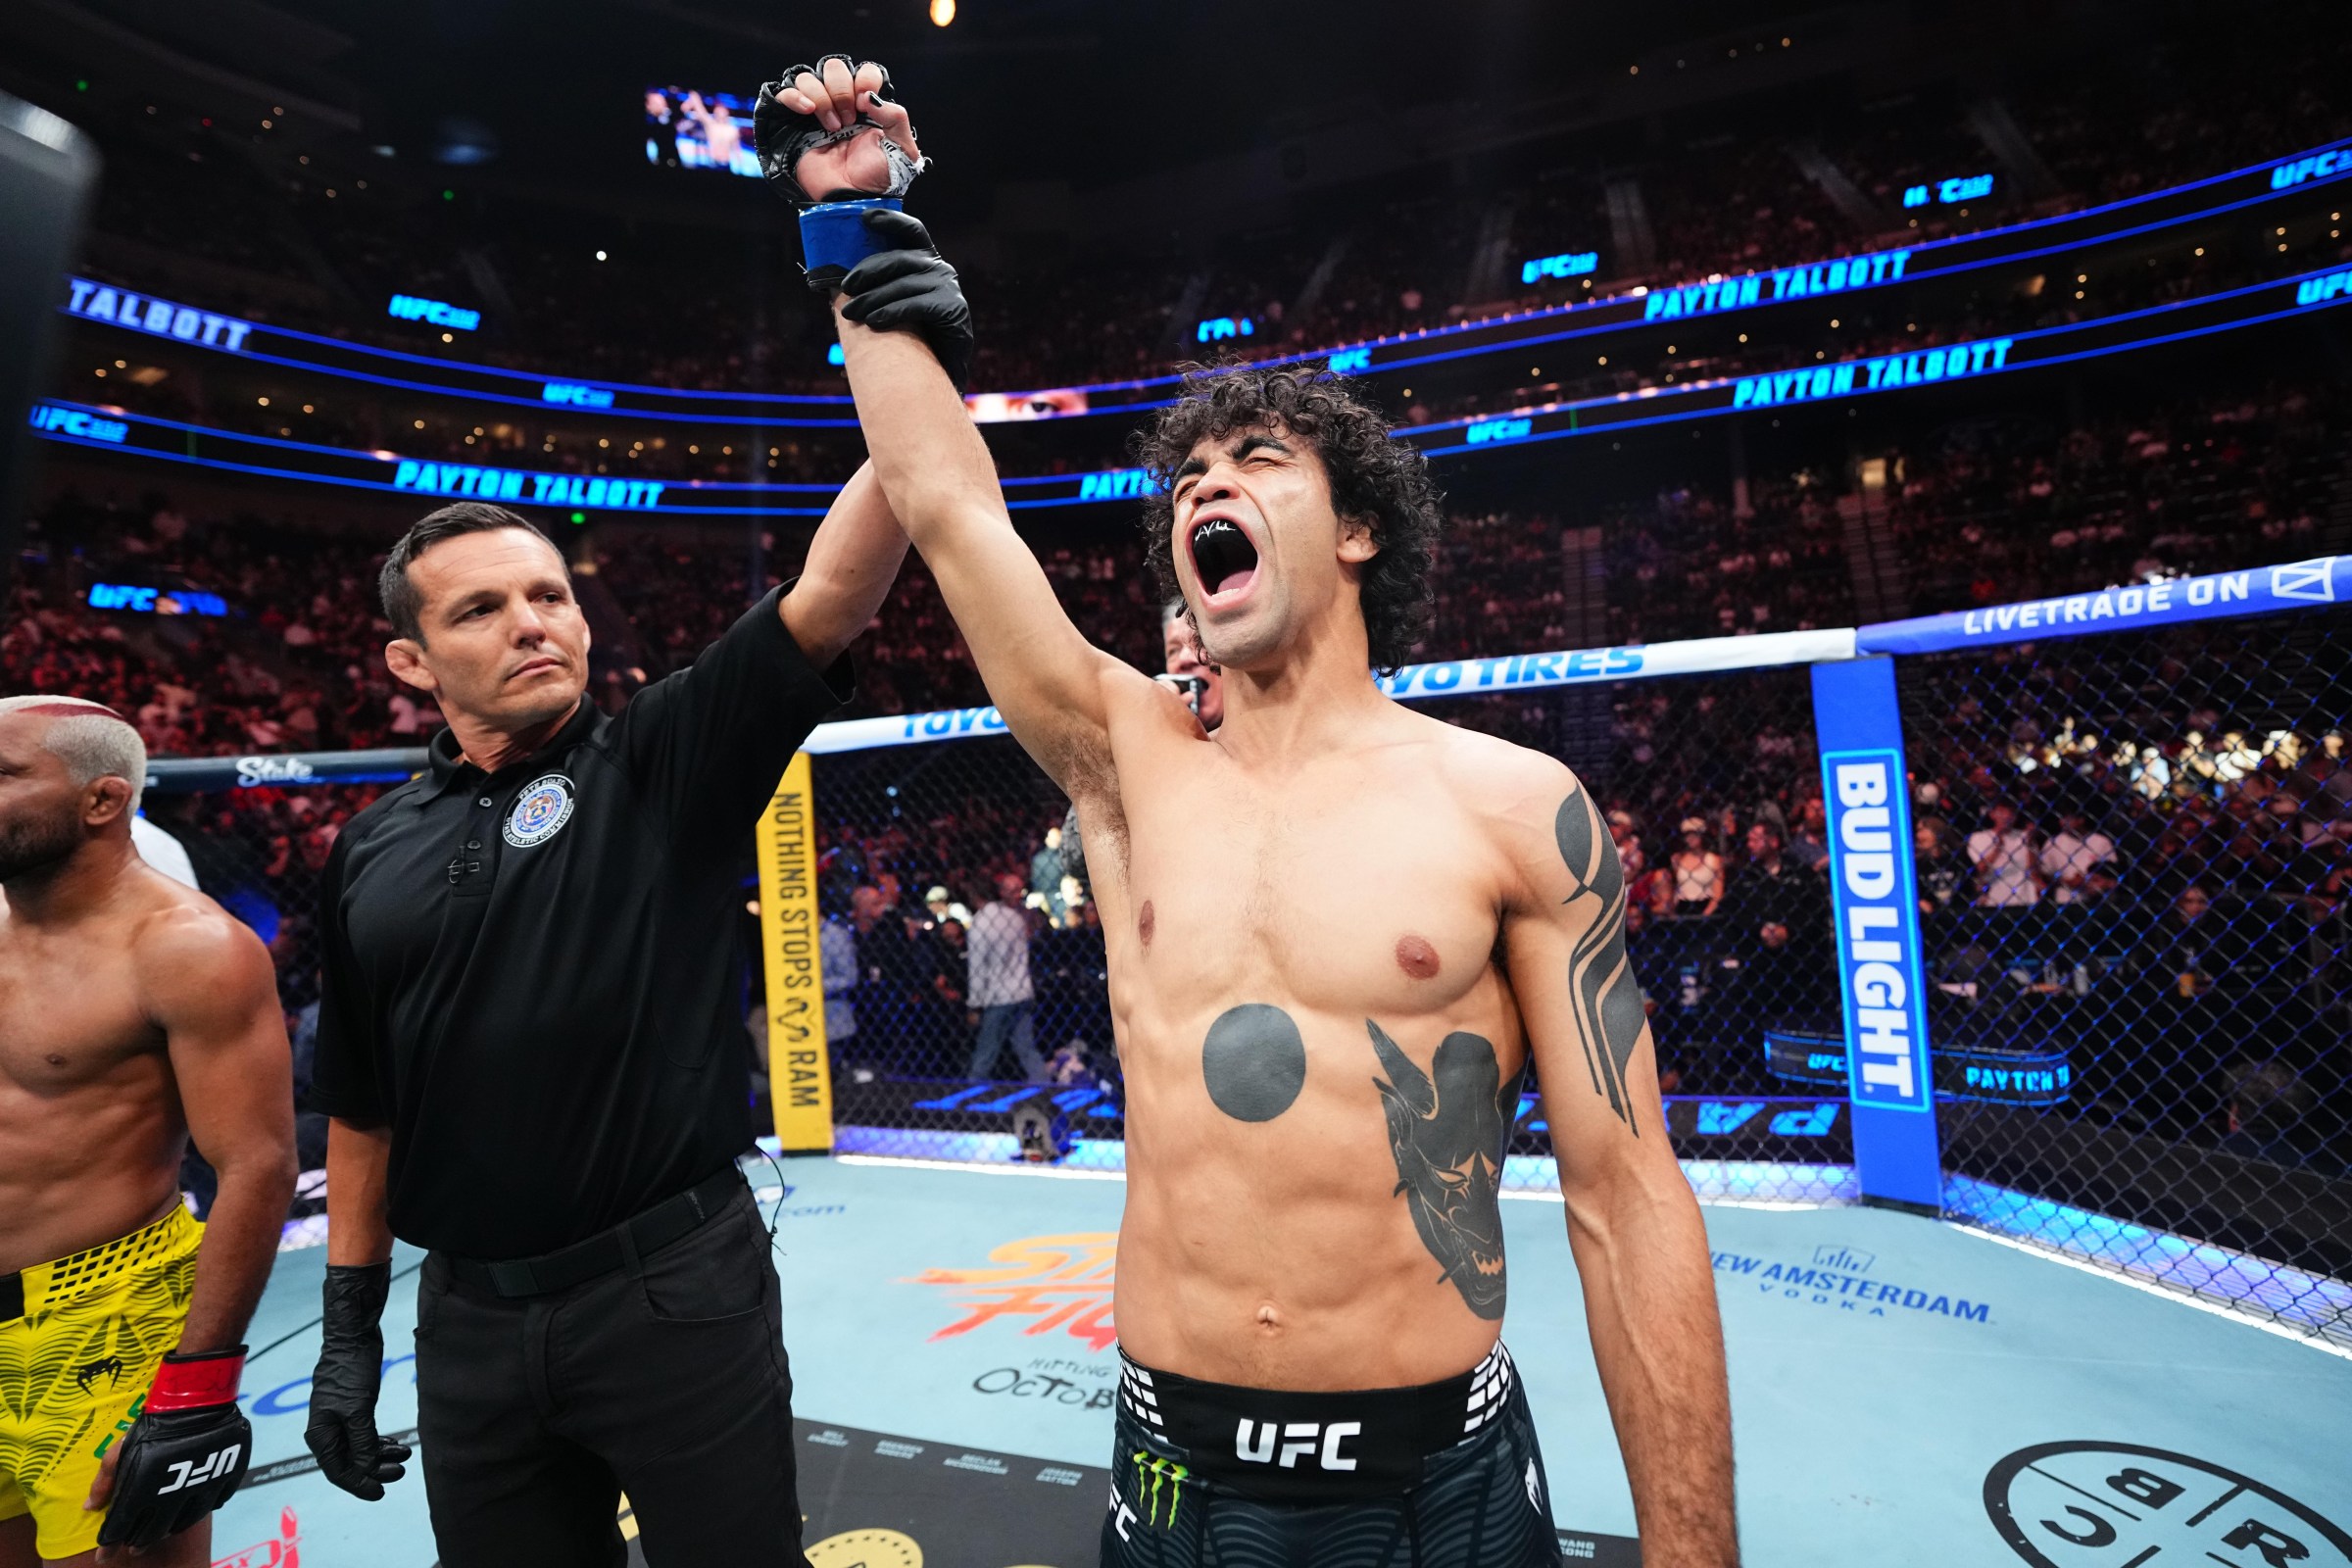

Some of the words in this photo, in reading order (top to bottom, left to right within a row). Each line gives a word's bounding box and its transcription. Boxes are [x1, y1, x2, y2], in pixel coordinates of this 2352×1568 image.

[2270, 150, 2338, 191] UFC
[69, 278, 252, 352] TALBOTT
[1644, 275, 1761, 322] PAYTON
[1772, 250, 1910, 301] TALBOTT
[1733, 363, 1855, 410] PAYTON
[1866, 338, 2013, 390] TALBOTT
[28, 405, 93, 437] UFC
[394, 459, 525, 501] PAYTON
[534, 474, 664, 509] TALBOTT
[1963, 583, 2173, 636] LIVETRADE
[2186, 571, 2250, 604] ON
[1372, 663, 1464, 695] YO
[1476, 644, 1645, 687] TIRES
[235, 756, 314, 787] Stake
[773, 792, 808, 901] NOTHING
[1836, 762, 1896, 901] BUD
[780, 907, 812, 990] STOPS
[1847, 906, 1915, 1099] LIGHT
[788, 1049, 821, 1108] RAM
[900, 1232, 1119, 1285] ST
[1709, 1251, 1762, 1274] EW
[1762, 1262, 1991, 1324] AMSTERDAM
[1759, 1283, 1886, 1318] VODKA
[972, 1366, 1116, 1411] OCTOB
[157, 1443, 242, 1495] UFC
[1236, 1417, 1362, 1472] UFC
[1108, 1472, 1138, 1544] FC
